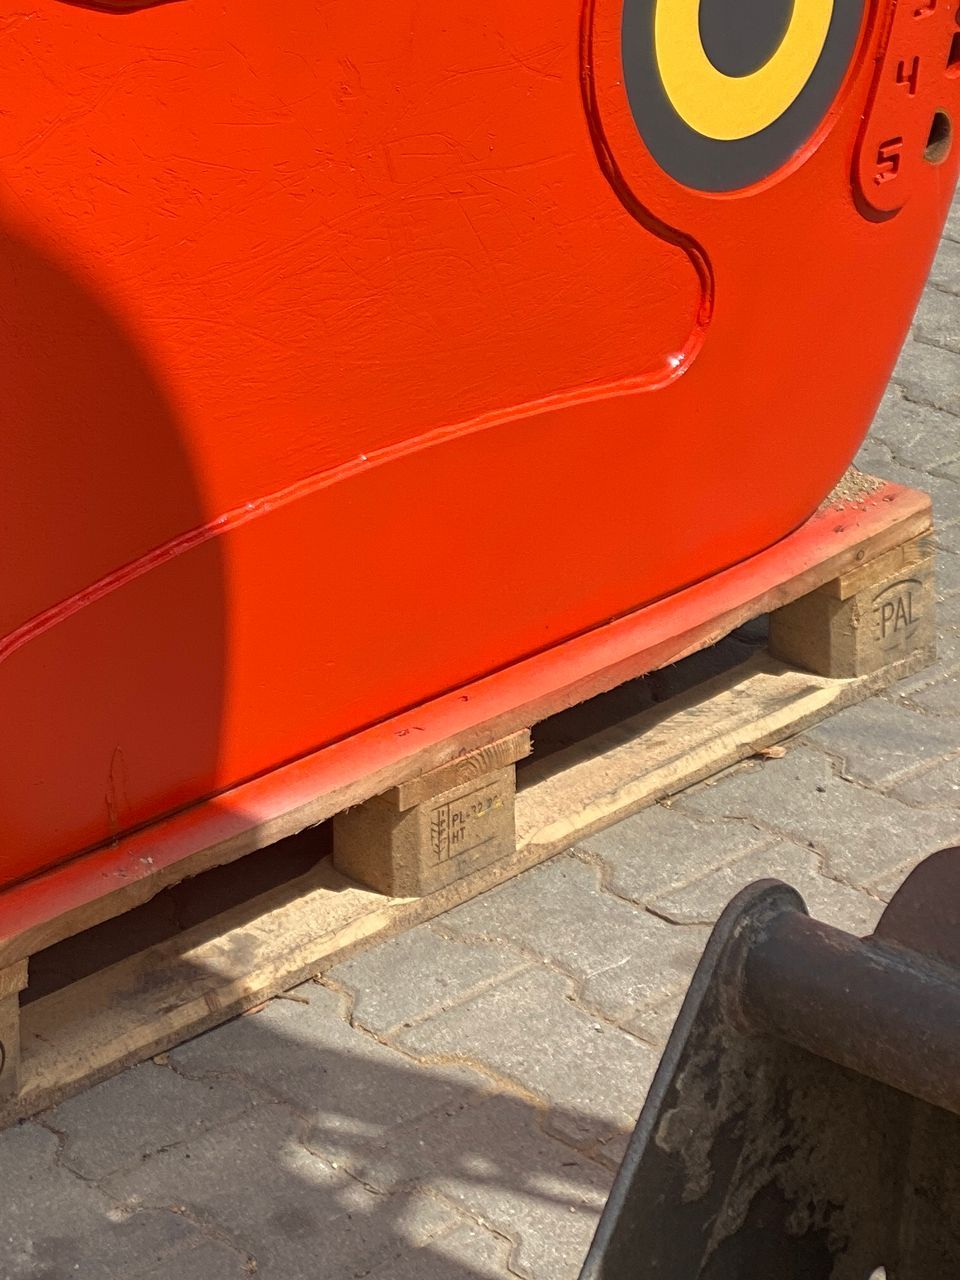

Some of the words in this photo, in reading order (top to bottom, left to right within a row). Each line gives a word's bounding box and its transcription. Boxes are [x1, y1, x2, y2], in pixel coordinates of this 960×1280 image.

[896, 56, 920, 97] 4
[874, 136, 903, 187] 5
[452, 826, 466, 844] HT
